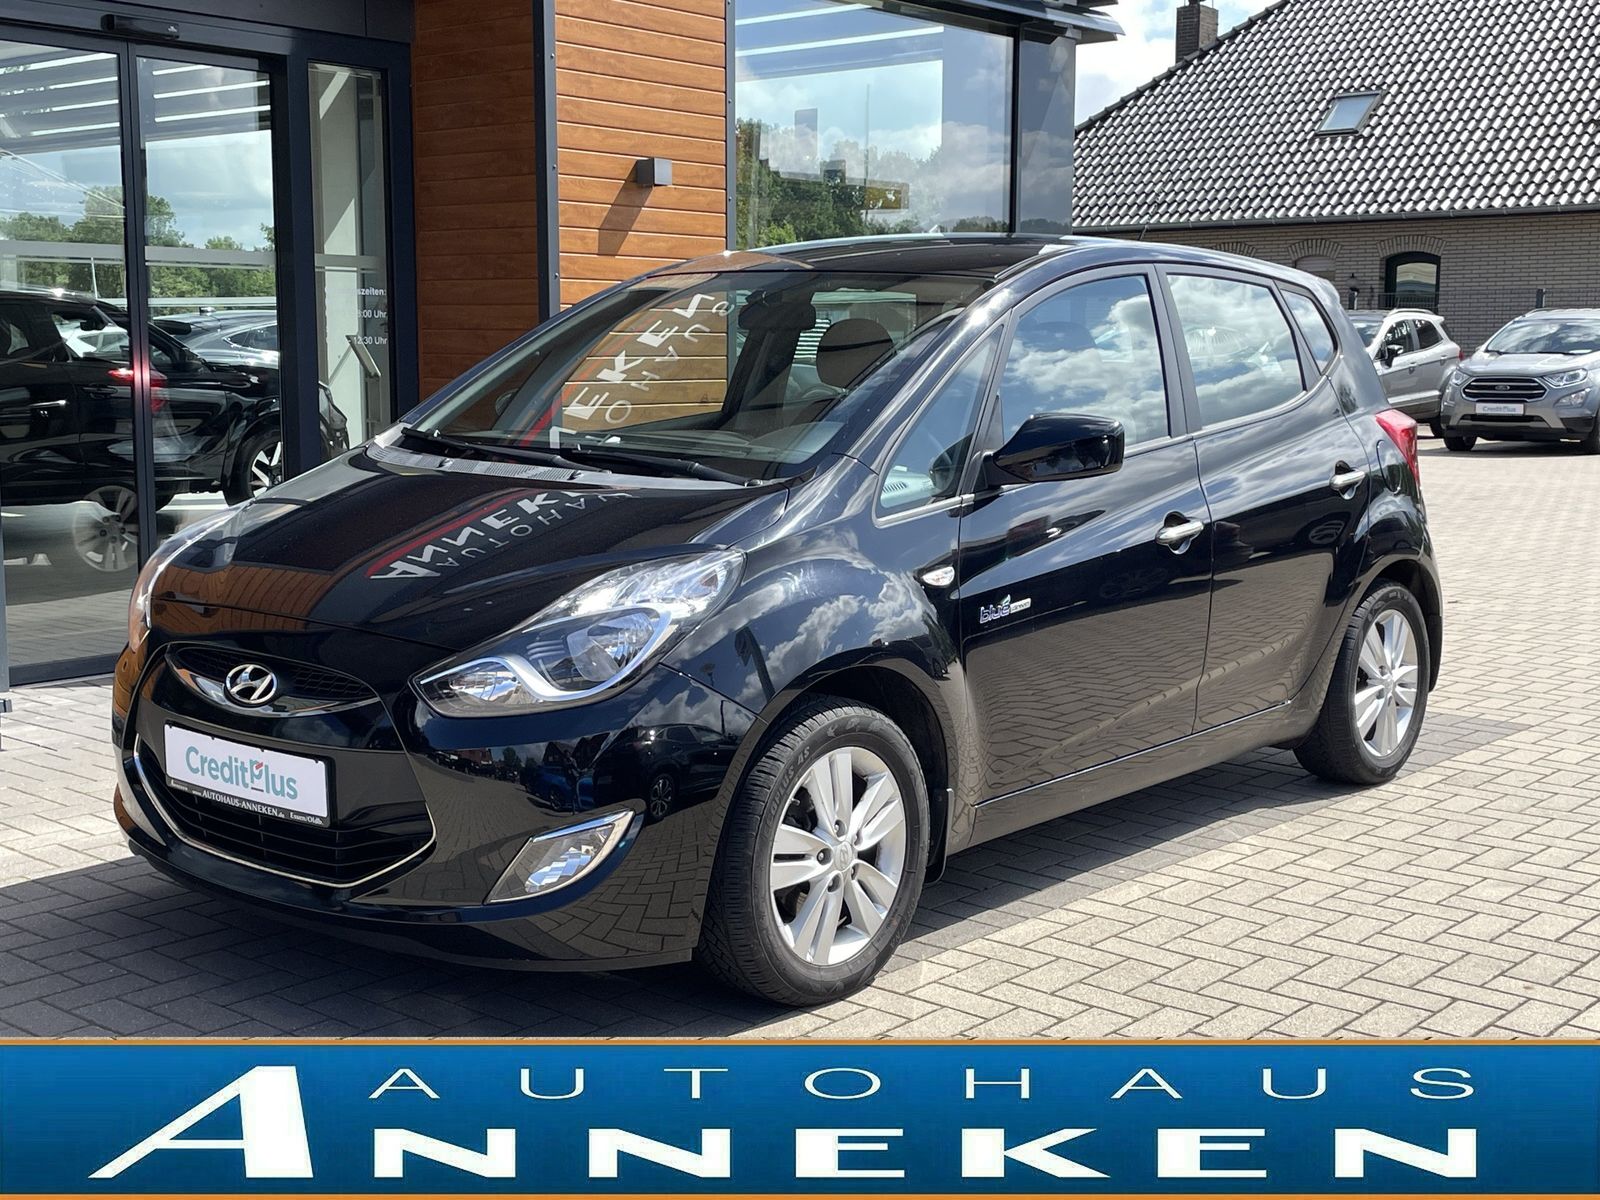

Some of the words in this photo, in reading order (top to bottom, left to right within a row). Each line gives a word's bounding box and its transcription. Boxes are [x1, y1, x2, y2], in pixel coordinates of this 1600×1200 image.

[373, 310, 387, 318] Uhr
[374, 336, 388, 345] Uhr
[980, 601, 1010, 623] blue
[185, 745, 298, 800] CreditPlus
